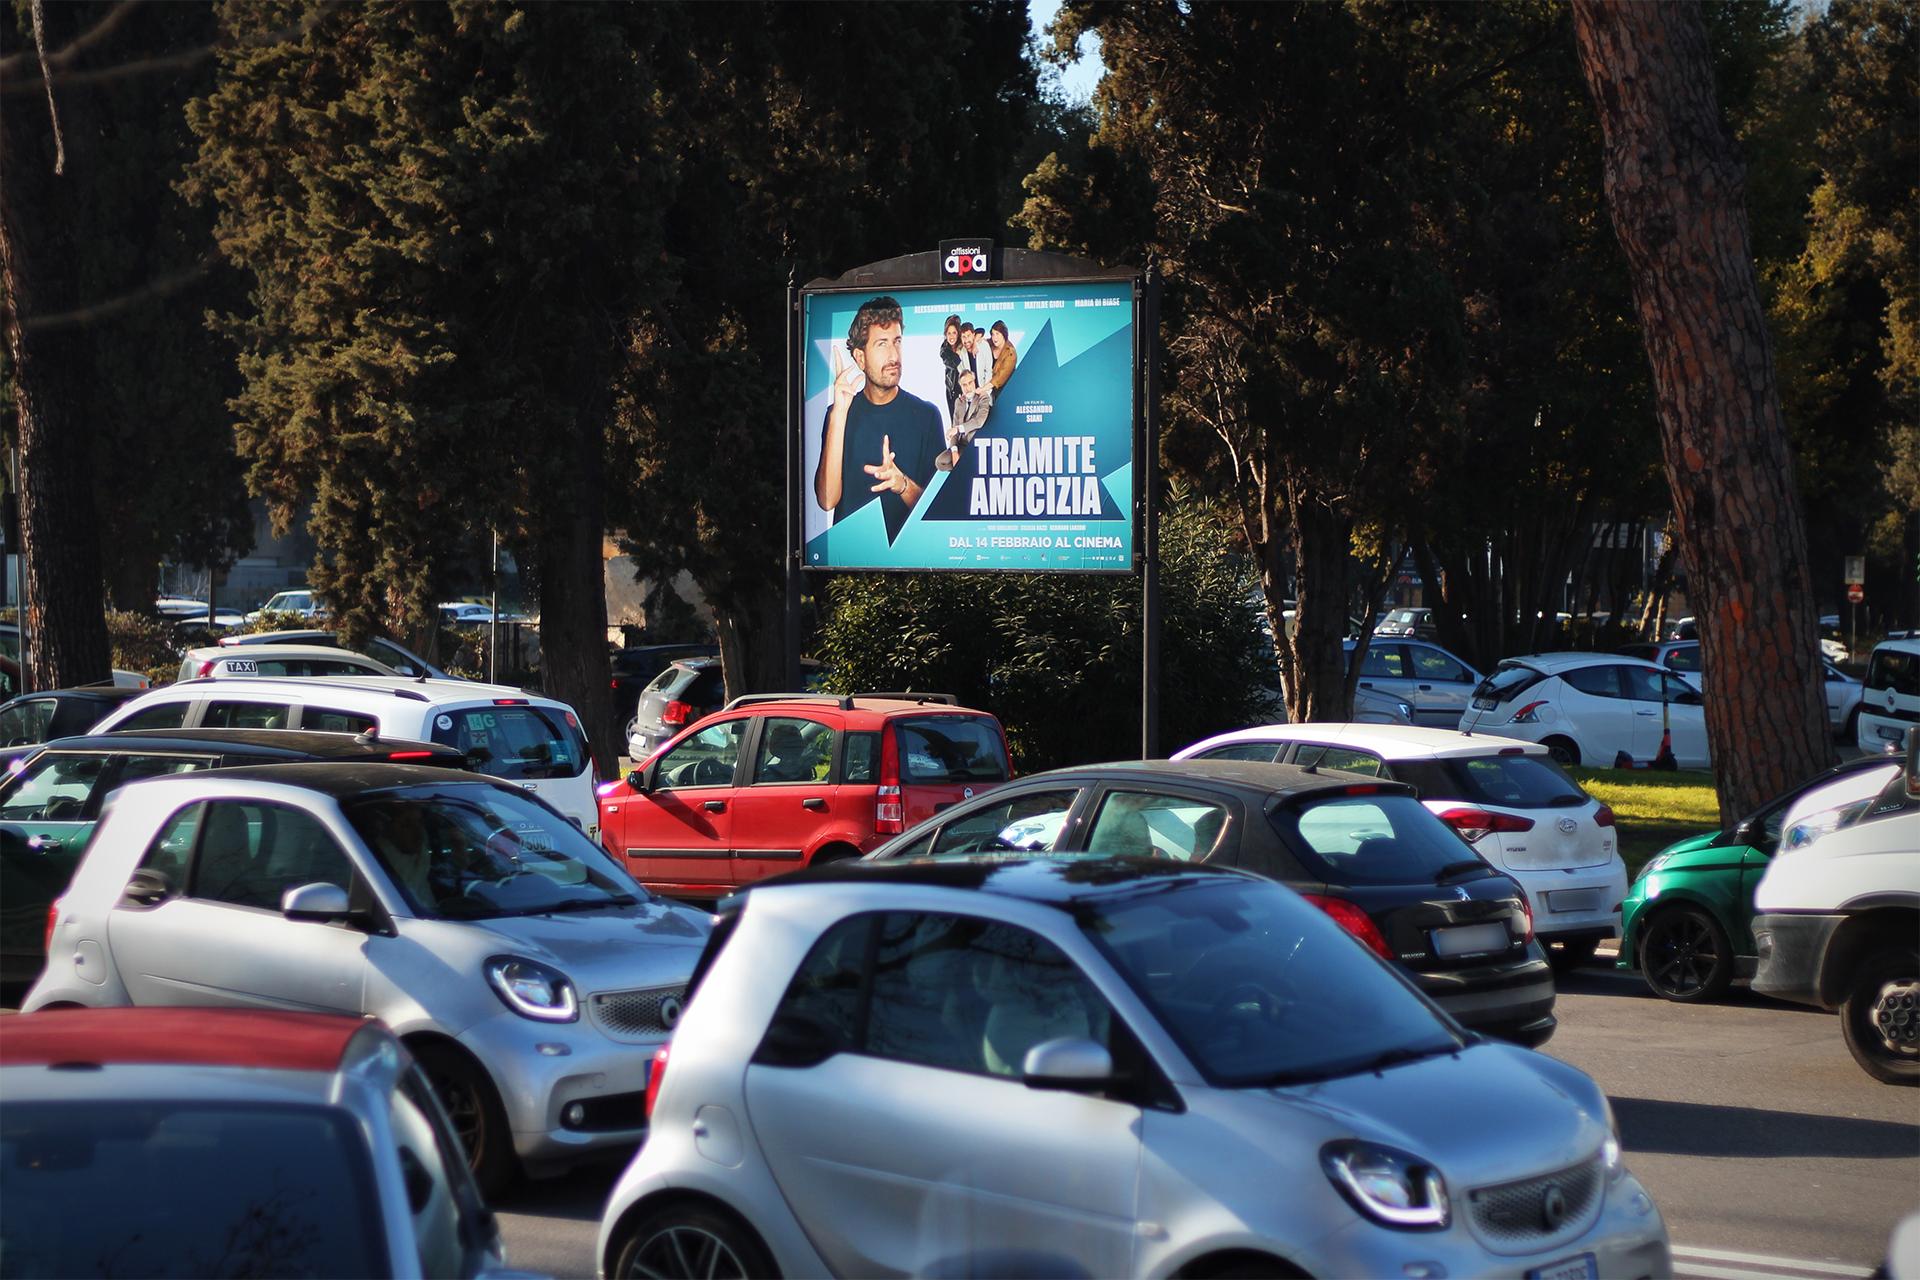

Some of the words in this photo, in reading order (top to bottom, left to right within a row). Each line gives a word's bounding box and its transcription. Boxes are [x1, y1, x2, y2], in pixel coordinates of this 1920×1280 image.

[945, 254, 987, 276] apa
[1075, 299, 1094, 307] MARIA
[1102, 298, 1120, 306] BIASE
[1016, 405, 1053, 414] ALESSANDRO
[1026, 414, 1043, 423] SIANI
[974, 436, 1096, 475] TRAMITE
[969, 476, 1102, 516] AMICIZIA
[949, 537, 973, 548] DAL
[976, 537, 988, 548] 14
[991, 536, 1051, 548] FEBBRAIO
[1055, 536, 1071, 547] AL
[1074, 536, 1122, 548] CINEMA
[227, 662, 256, 671] TAXI
